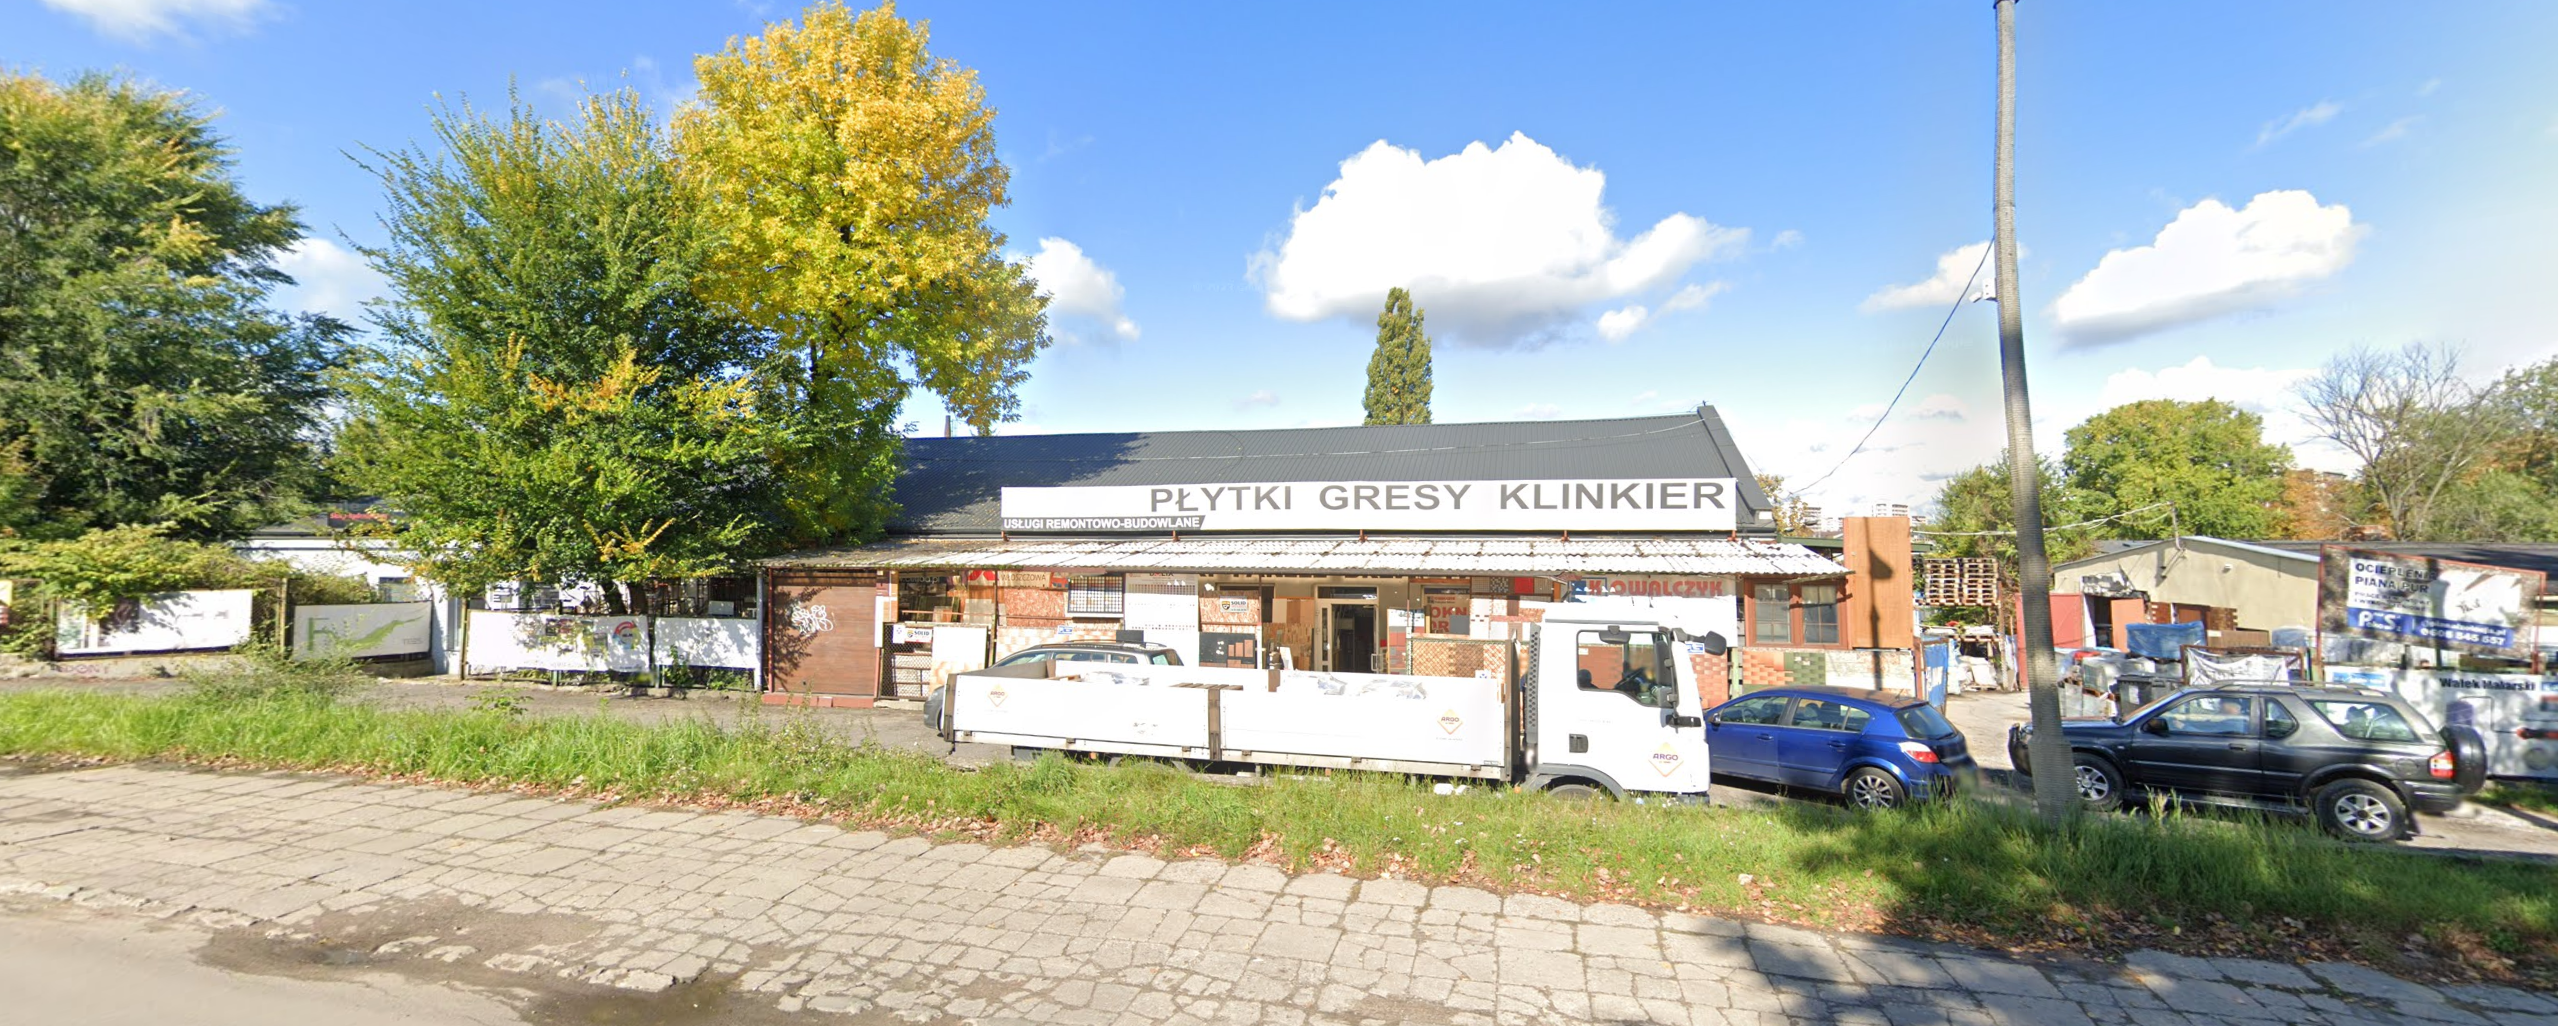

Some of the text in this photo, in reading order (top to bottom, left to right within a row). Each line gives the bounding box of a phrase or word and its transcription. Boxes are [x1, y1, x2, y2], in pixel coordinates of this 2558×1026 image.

[1150, 482, 1726, 512] PŁYTKI GRESY KLINKIER
[1003, 516, 1200, 529] USŁUGI REMONTOWO-BUDOWLANE
[1431, 606, 1468, 619] OKN
[1652, 753, 1679, 761] ARGO
